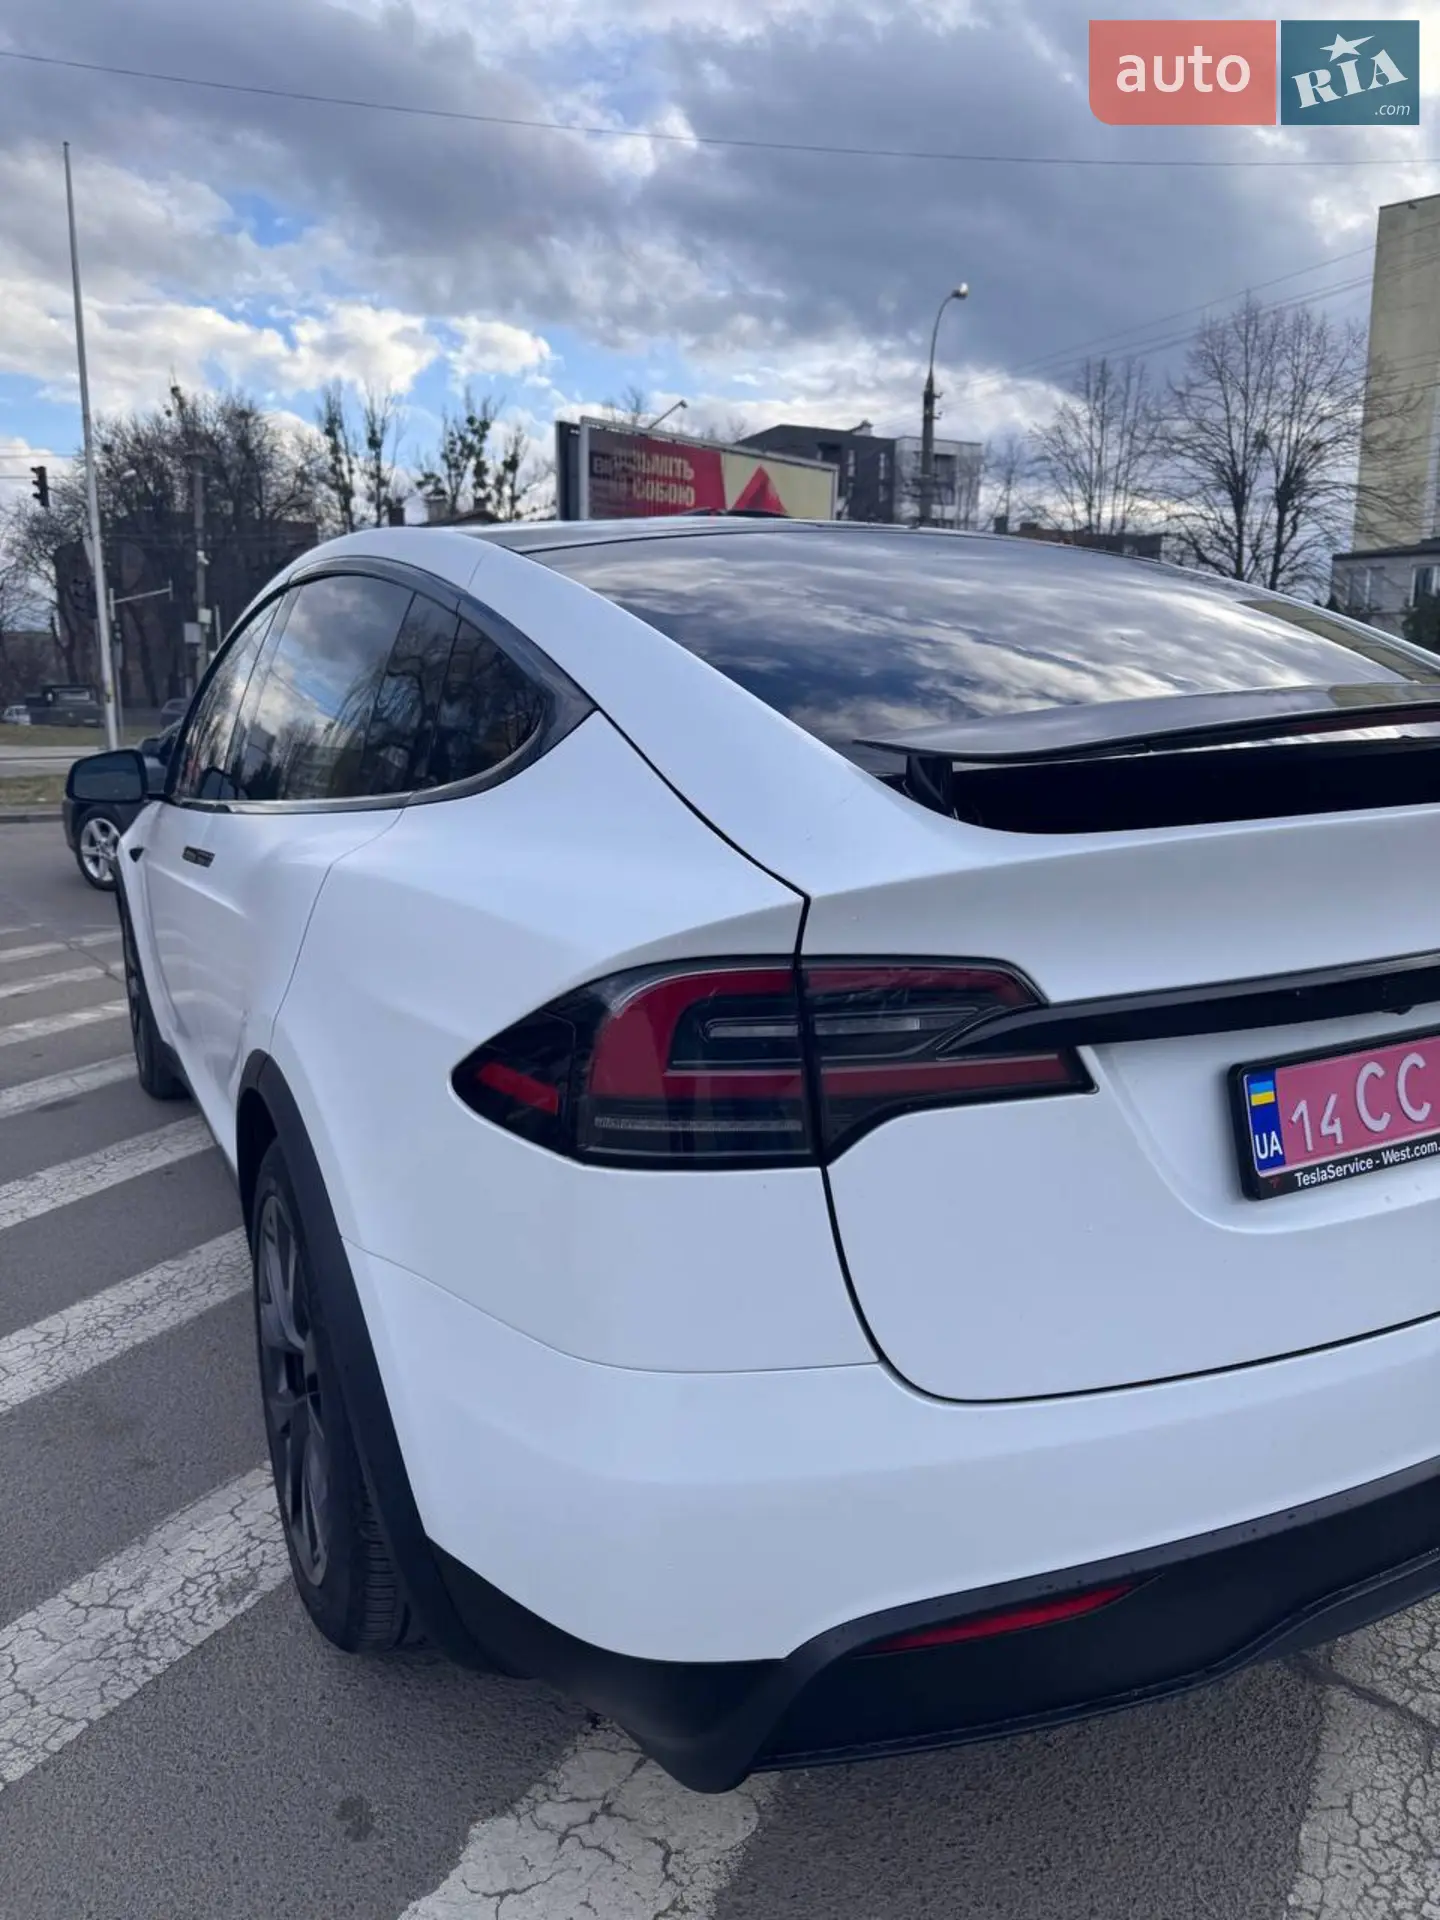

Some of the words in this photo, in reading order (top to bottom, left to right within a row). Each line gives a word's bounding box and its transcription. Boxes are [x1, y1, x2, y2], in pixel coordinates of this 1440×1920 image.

[1291, 1093, 1344, 1152] 14
[1356, 1052, 1432, 1132] CC
[1254, 1131, 1284, 1160] UA
[1294, 1155, 1374, 1188] TeslaService
